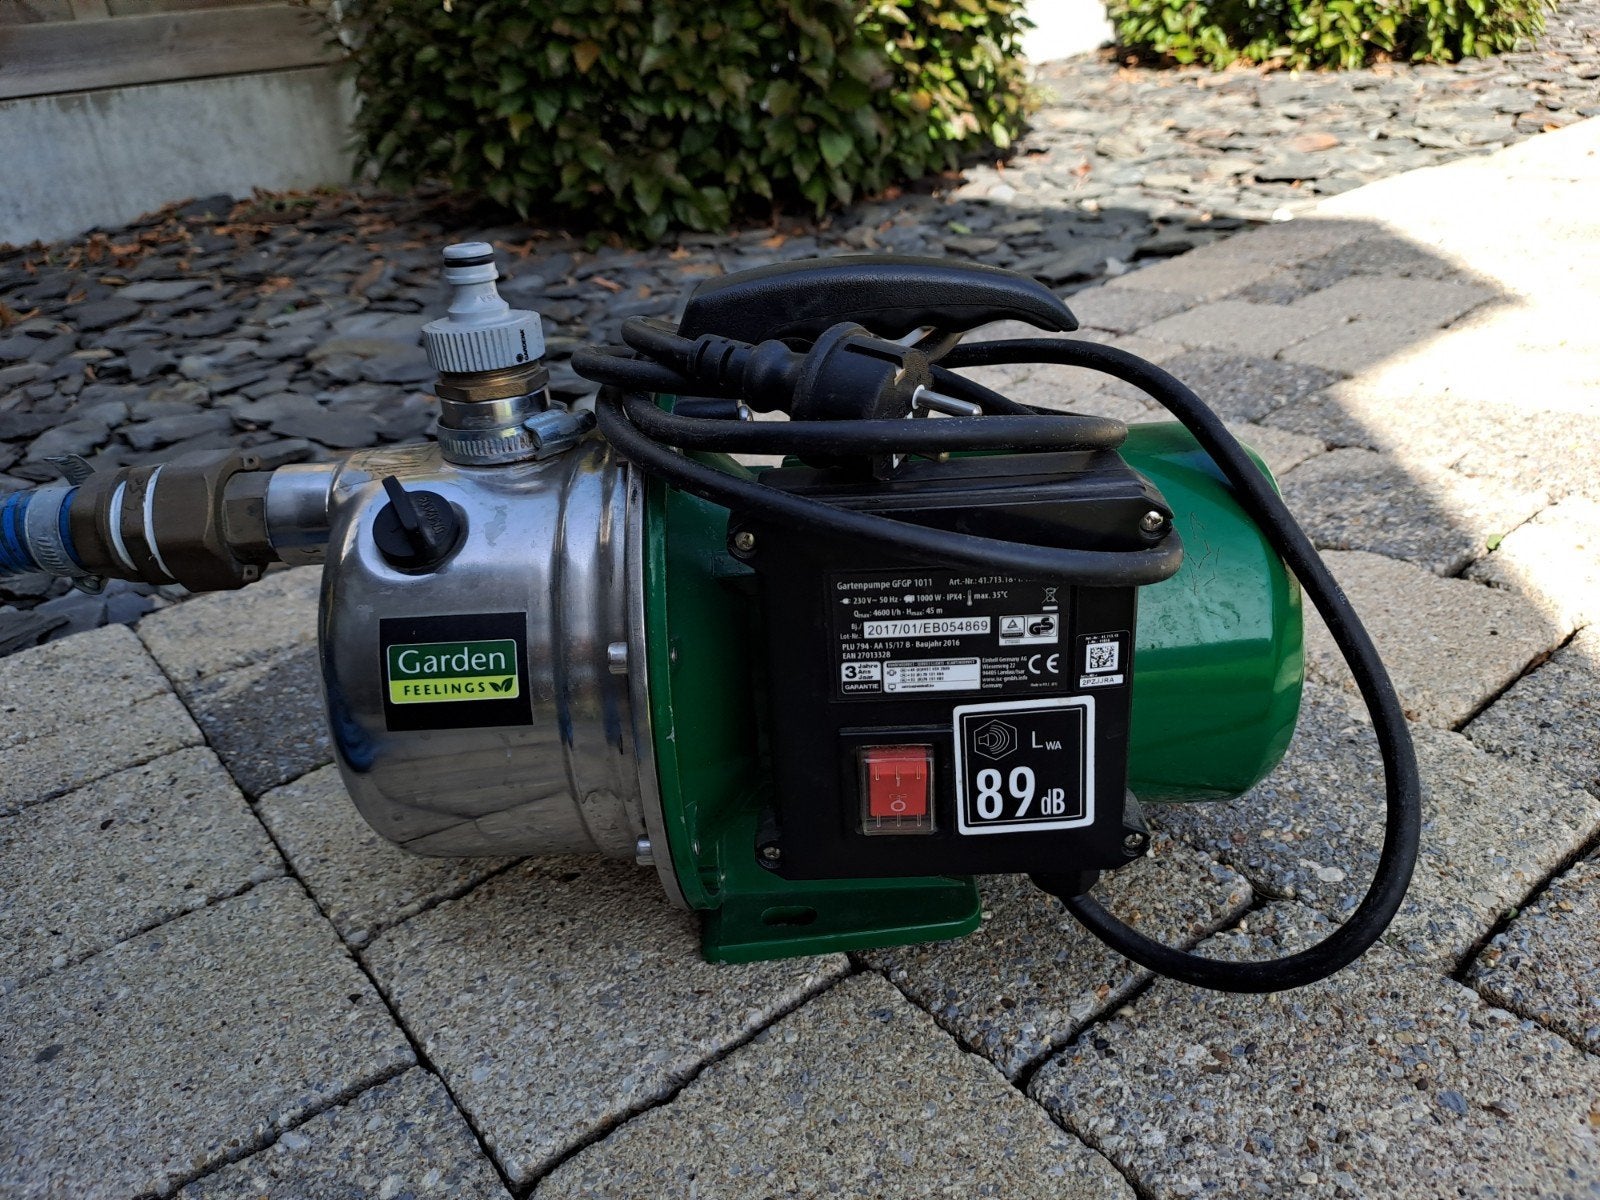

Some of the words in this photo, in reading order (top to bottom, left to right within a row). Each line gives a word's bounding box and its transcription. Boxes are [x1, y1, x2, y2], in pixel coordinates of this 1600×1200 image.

[836, 581, 890, 591] Gartenpumpe
[892, 579, 912, 588] GFGP
[914, 578, 932, 587] 1011
[853, 597, 866, 605] 230
[917, 594, 933, 602] 1000
[946, 593, 962, 601] IPX4
[992, 590, 1008, 599] 35°C
[867, 620, 988, 636] 2017/01/EB054869
[842, 643, 855, 651] PLU
[856, 642, 869, 650] 794
[873, 642, 883, 650] AA
[885, 641, 903, 649] 15/17
[915, 640, 942, 650] Baujahr
[943, 639, 960, 647] 2016
[397, 646, 506, 674] Garden
[1028, 653, 1060, 675] CE
[845, 665, 857, 679] 3
[404, 681, 486, 696] FEELINGS
[976, 766, 1036, 820] 89
[1041, 787, 1065, 815] dB
